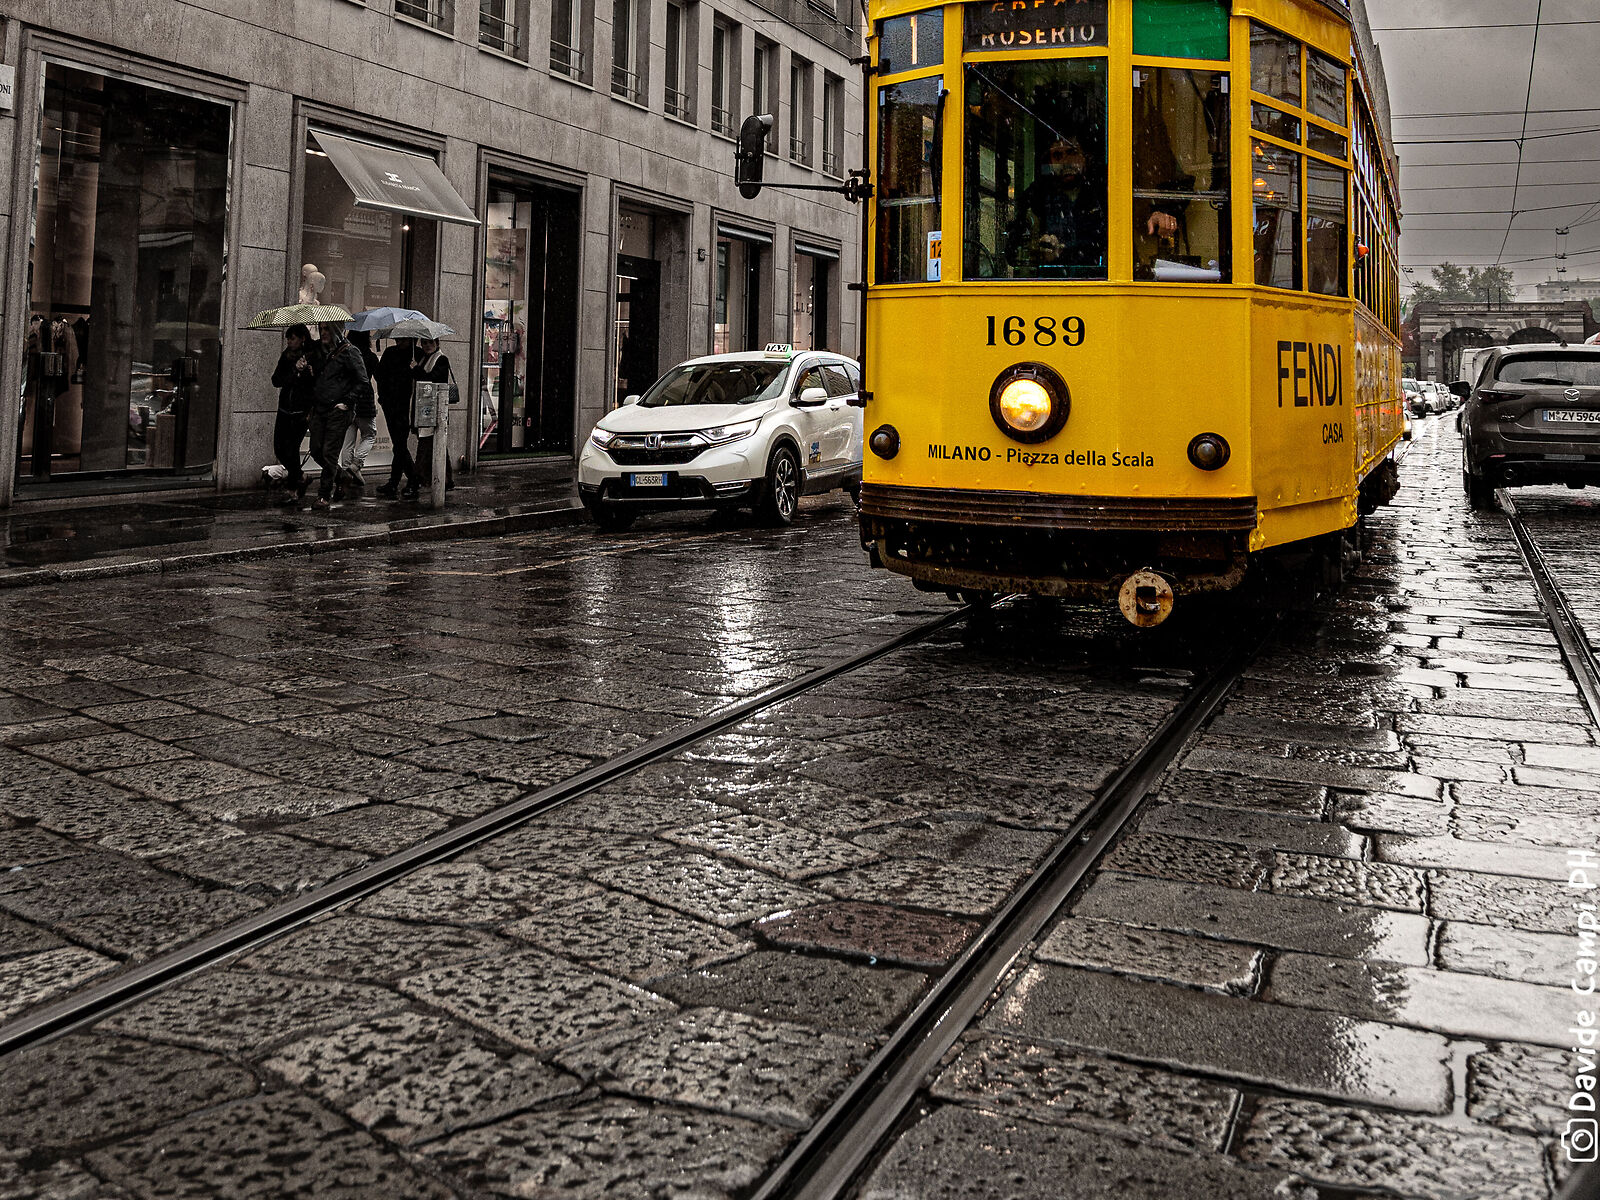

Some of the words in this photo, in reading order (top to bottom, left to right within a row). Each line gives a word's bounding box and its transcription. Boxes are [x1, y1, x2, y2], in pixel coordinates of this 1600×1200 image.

[985, 315, 1086, 347] 1689
[766, 344, 790, 352] TAXI
[1277, 340, 1343, 408] FENDI
[1322, 422, 1344, 445] CASA
[928, 443, 992, 462] MILANO
[1006, 448, 1060, 465] Piazza
[1064, 449, 1107, 467] della
[1111, 451, 1155, 468] Scala
